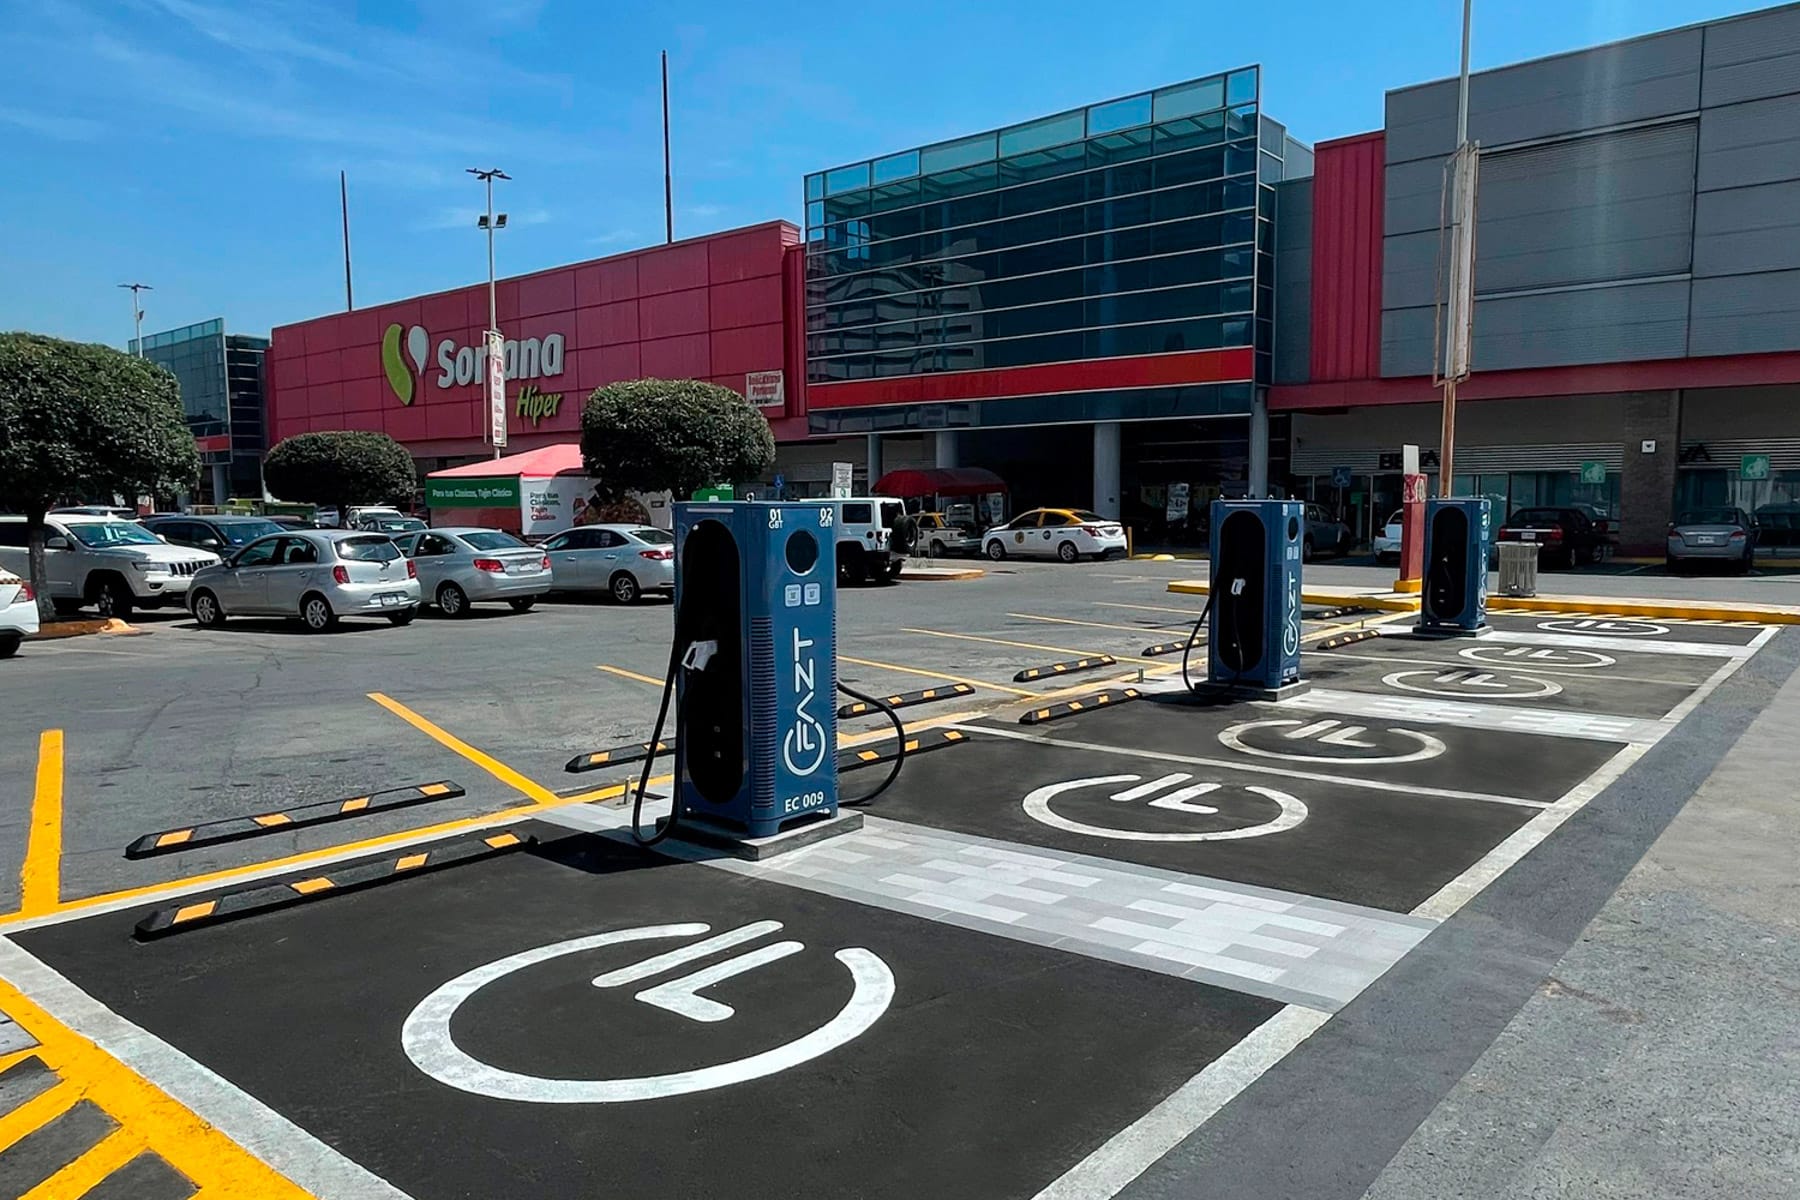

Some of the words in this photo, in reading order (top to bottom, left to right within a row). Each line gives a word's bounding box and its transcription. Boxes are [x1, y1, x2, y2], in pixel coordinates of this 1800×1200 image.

[437, 333, 564, 388] Sorana
[769, 508, 782, 521] 01
[820, 507, 833, 521] 02
[785, 796, 800, 813] EC
[802, 791, 824, 808] 009
